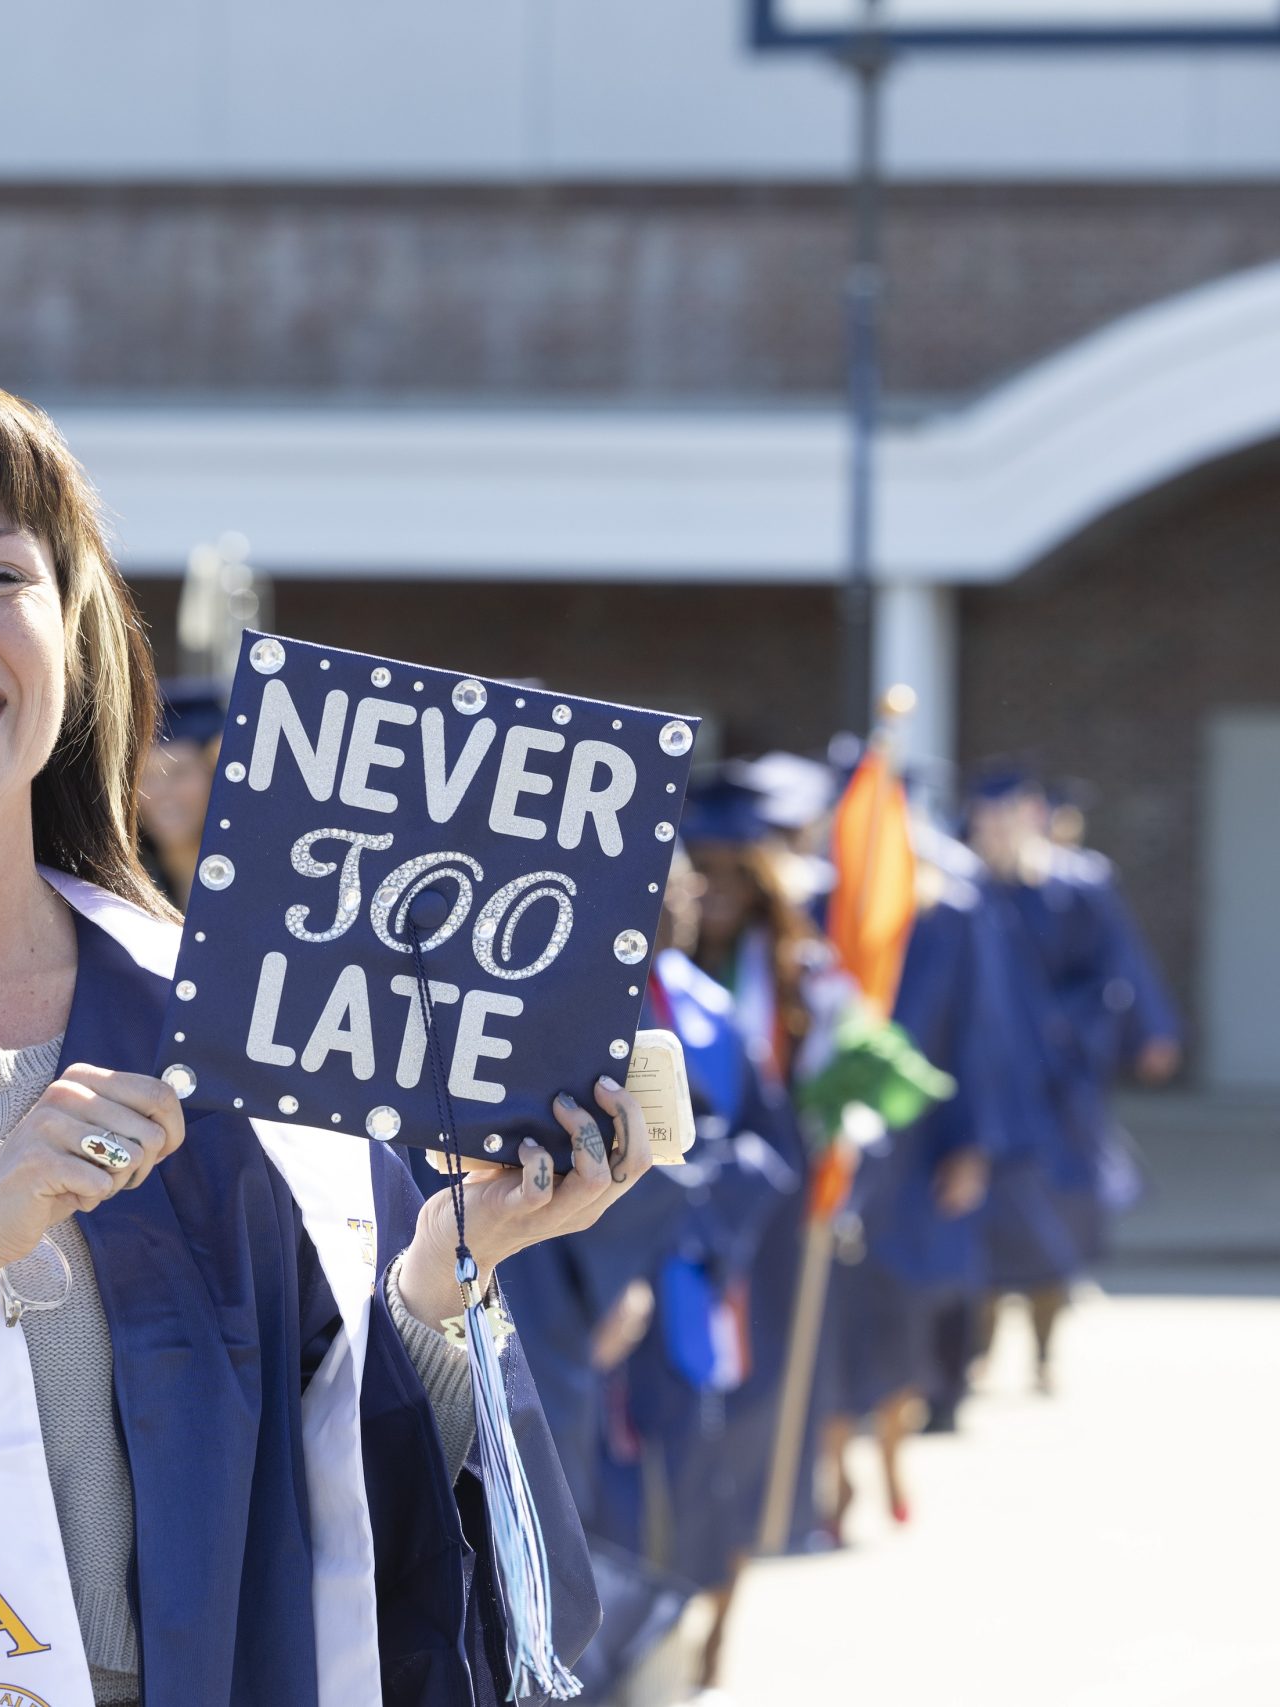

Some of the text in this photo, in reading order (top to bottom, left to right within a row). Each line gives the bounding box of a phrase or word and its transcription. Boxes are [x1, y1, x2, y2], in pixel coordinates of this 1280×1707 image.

[248, 679, 637, 857] NEVER
[285, 827, 578, 980] TOO
[246, 951, 524, 1104] LATE
